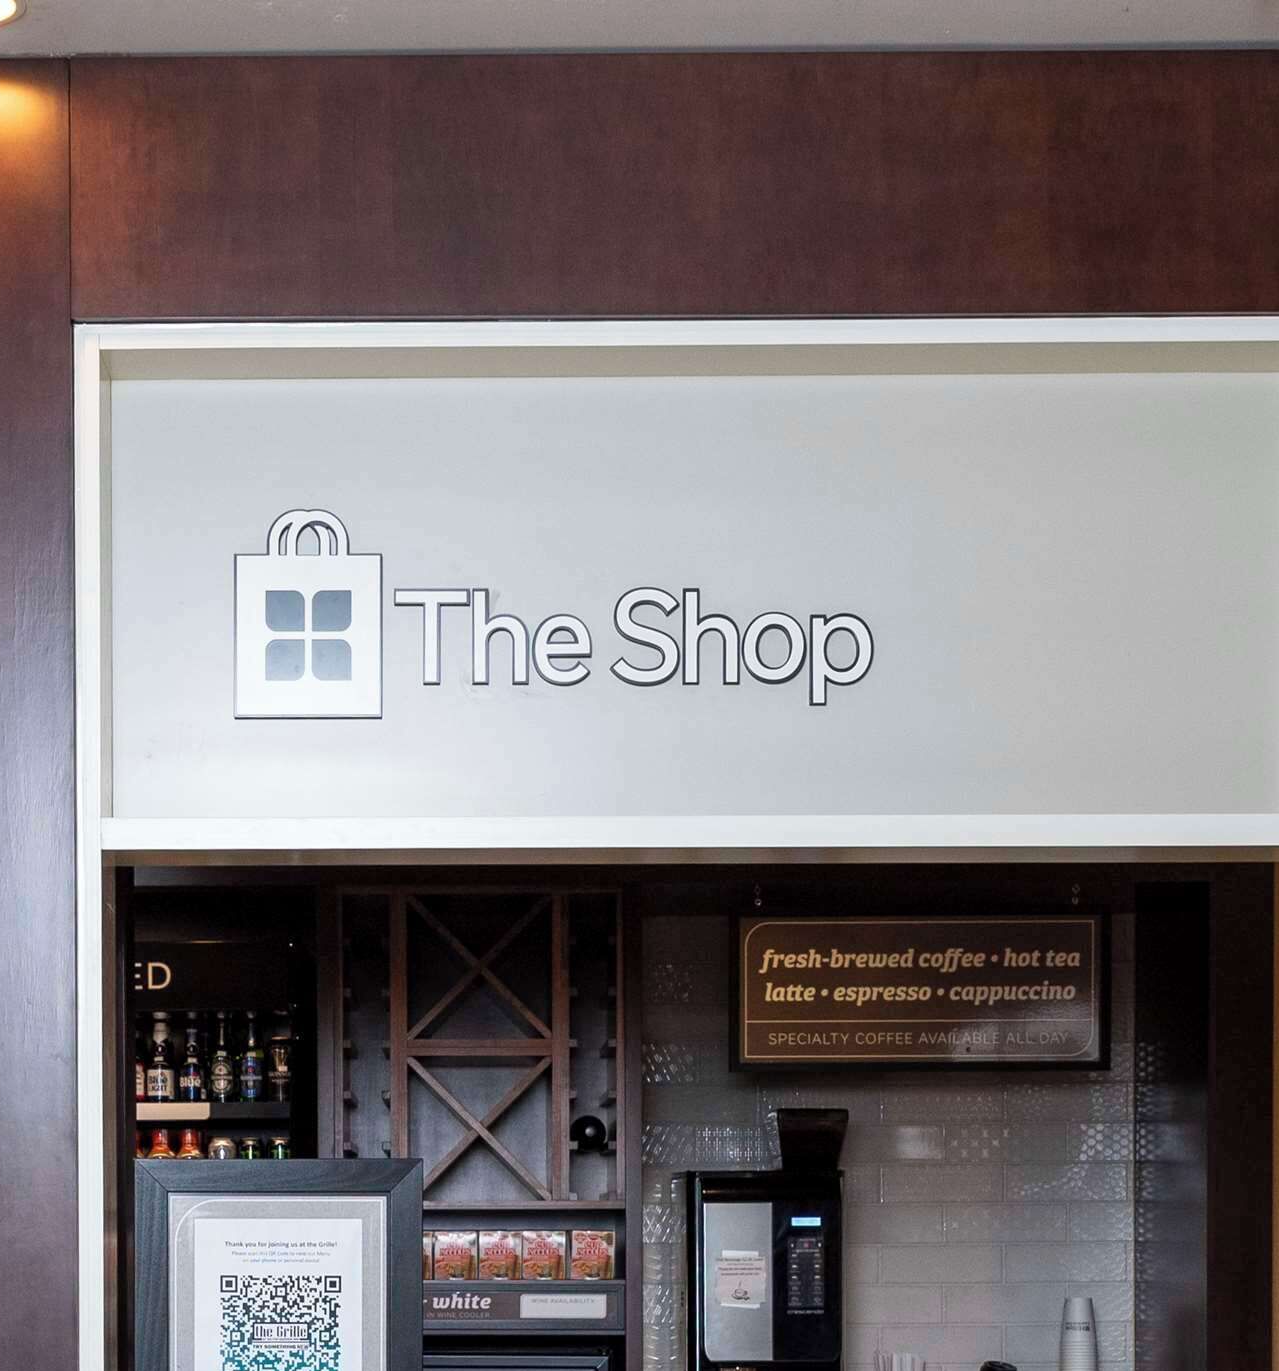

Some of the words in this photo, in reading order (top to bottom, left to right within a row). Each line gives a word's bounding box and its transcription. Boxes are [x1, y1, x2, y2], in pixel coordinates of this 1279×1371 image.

[394, 587, 592, 686] The
[610, 586, 875, 706] Shop
[759, 948, 914, 974] fresh-brewed
[918, 949, 986, 972] coffee
[1003, 948, 1039, 968] hot
[1045, 950, 1081, 968] tea
[765, 983, 816, 1002] latte
[833, 984, 931, 1007] espresso
[950, 981, 1077, 1006] cappuccino
[768, 1032, 849, 1046] SPECIALTY
[855, 1032, 913, 1046] COFFEE
[918, 1031, 1000, 1045] AVAILABLE
[1007, 1031, 1035, 1045] ALL
[1040, 1031, 1069, 1045] DAY
[432, 1292, 491, 1309] white
[255, 1326, 273, 1337] the
[276, 1326, 306, 1337] Grille
